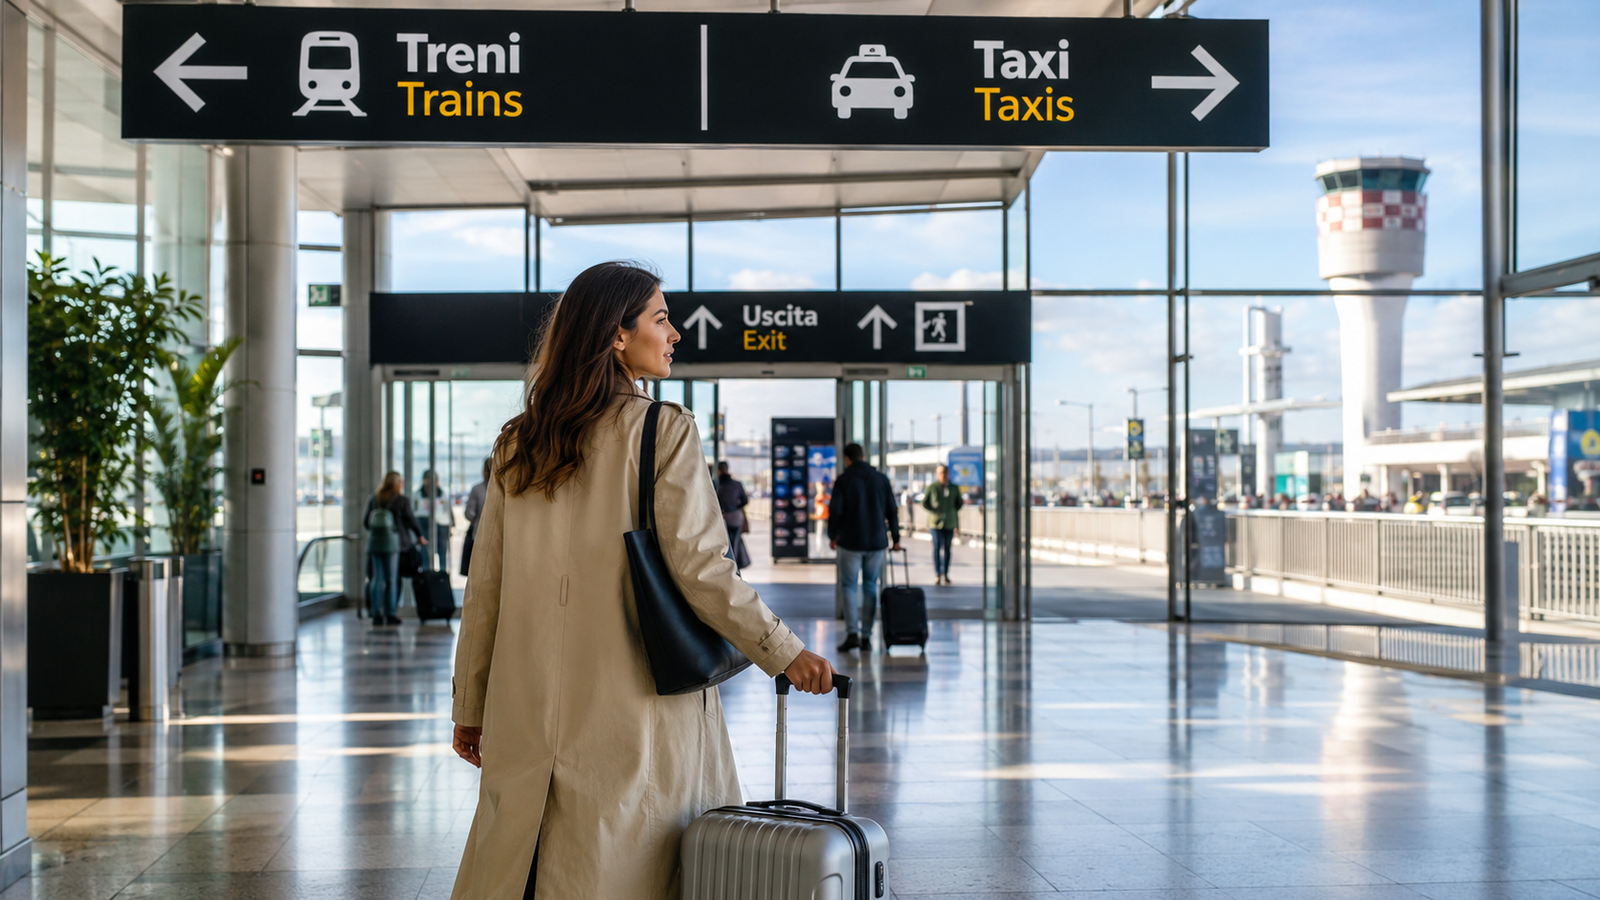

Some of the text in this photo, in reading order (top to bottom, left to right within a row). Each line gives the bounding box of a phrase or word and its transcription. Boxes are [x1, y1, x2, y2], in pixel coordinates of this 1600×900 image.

[396, 32, 521, 74] Treni
[973, 39, 1070, 80] Taxi
[397, 81, 523, 118] Trains
[974, 86, 1075, 122] Taxis
[742, 304, 819, 327] Uscita
[743, 330, 786, 351] Exit
